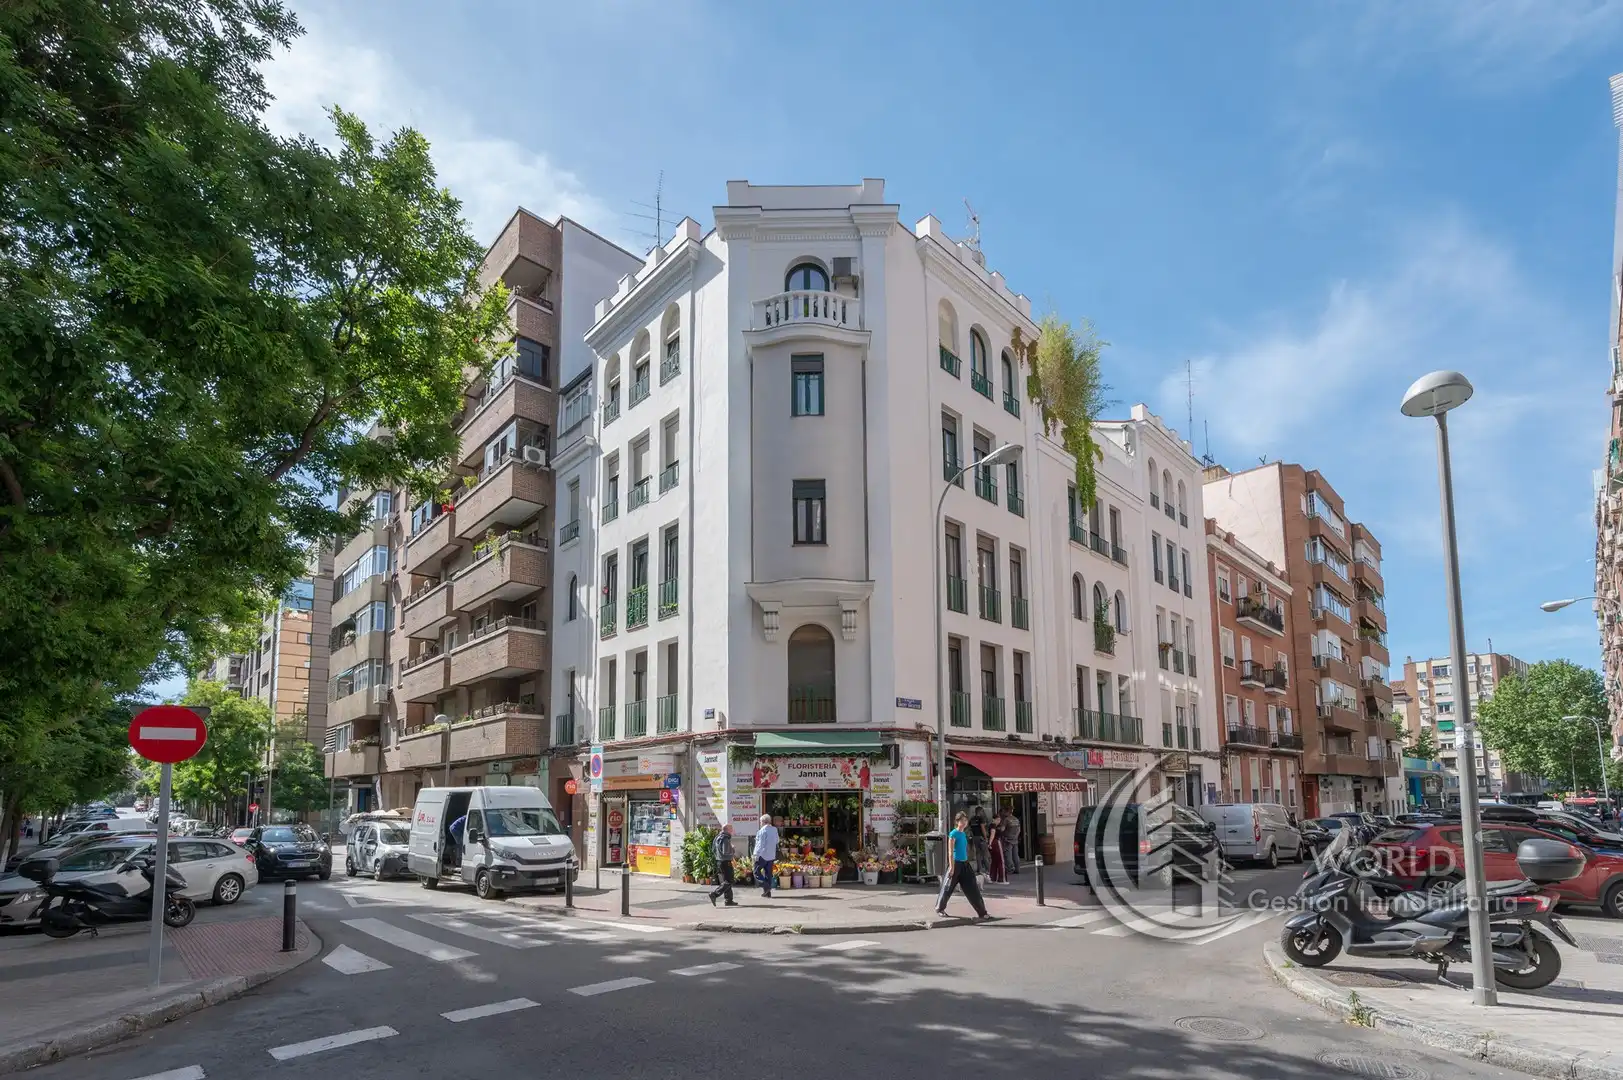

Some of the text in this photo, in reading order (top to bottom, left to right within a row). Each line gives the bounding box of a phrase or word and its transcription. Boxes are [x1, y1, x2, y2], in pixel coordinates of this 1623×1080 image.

[798, 770, 827, 778] Jannat
[1004, 782, 1080, 791] CAFETERIA PRISCILA
